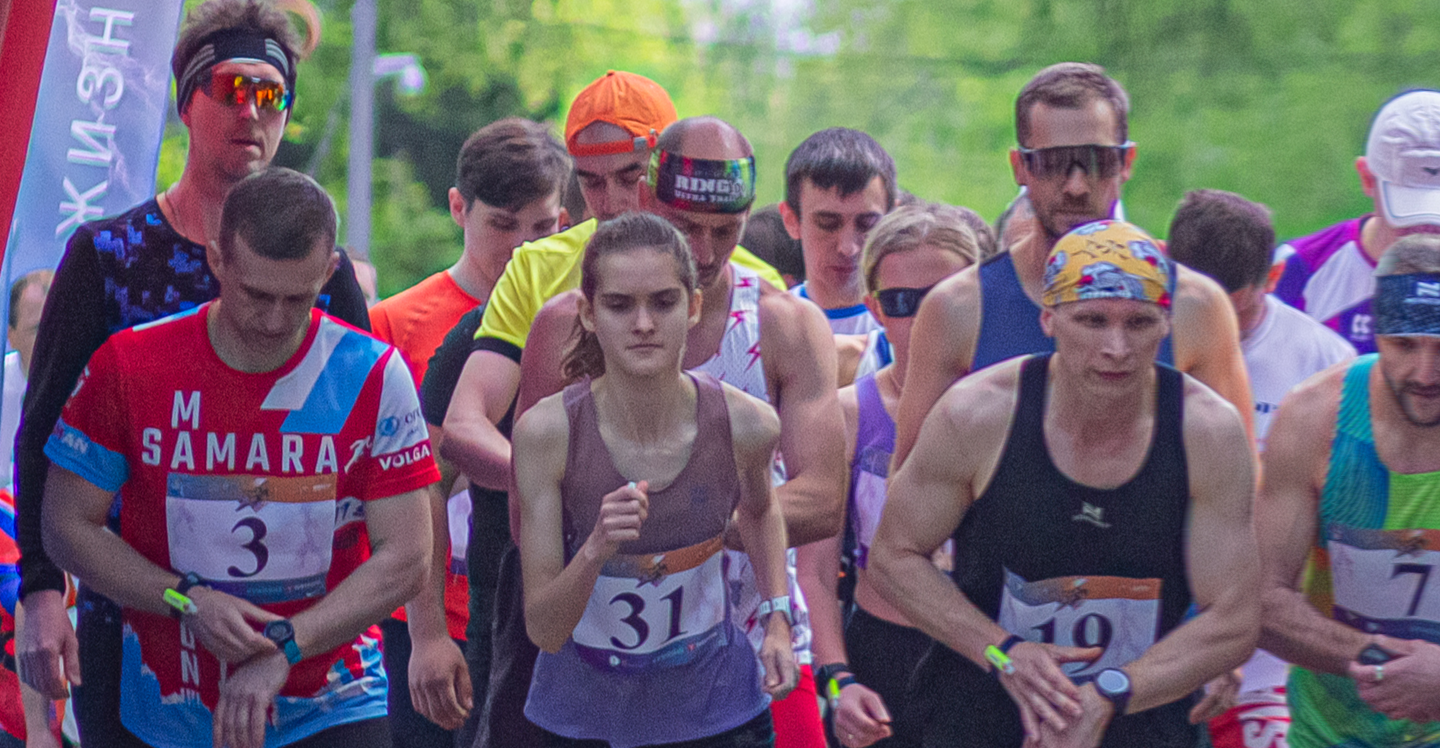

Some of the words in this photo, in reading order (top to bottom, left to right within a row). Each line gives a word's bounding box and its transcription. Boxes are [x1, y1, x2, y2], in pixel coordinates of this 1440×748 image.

[141, 427, 338, 474] SAMARA
[379, 444, 430, 471] VOLGA
[227, 515, 269, 578] 3
[1390, 562, 1435, 616] 7
[609, 585, 688, 650] 31
